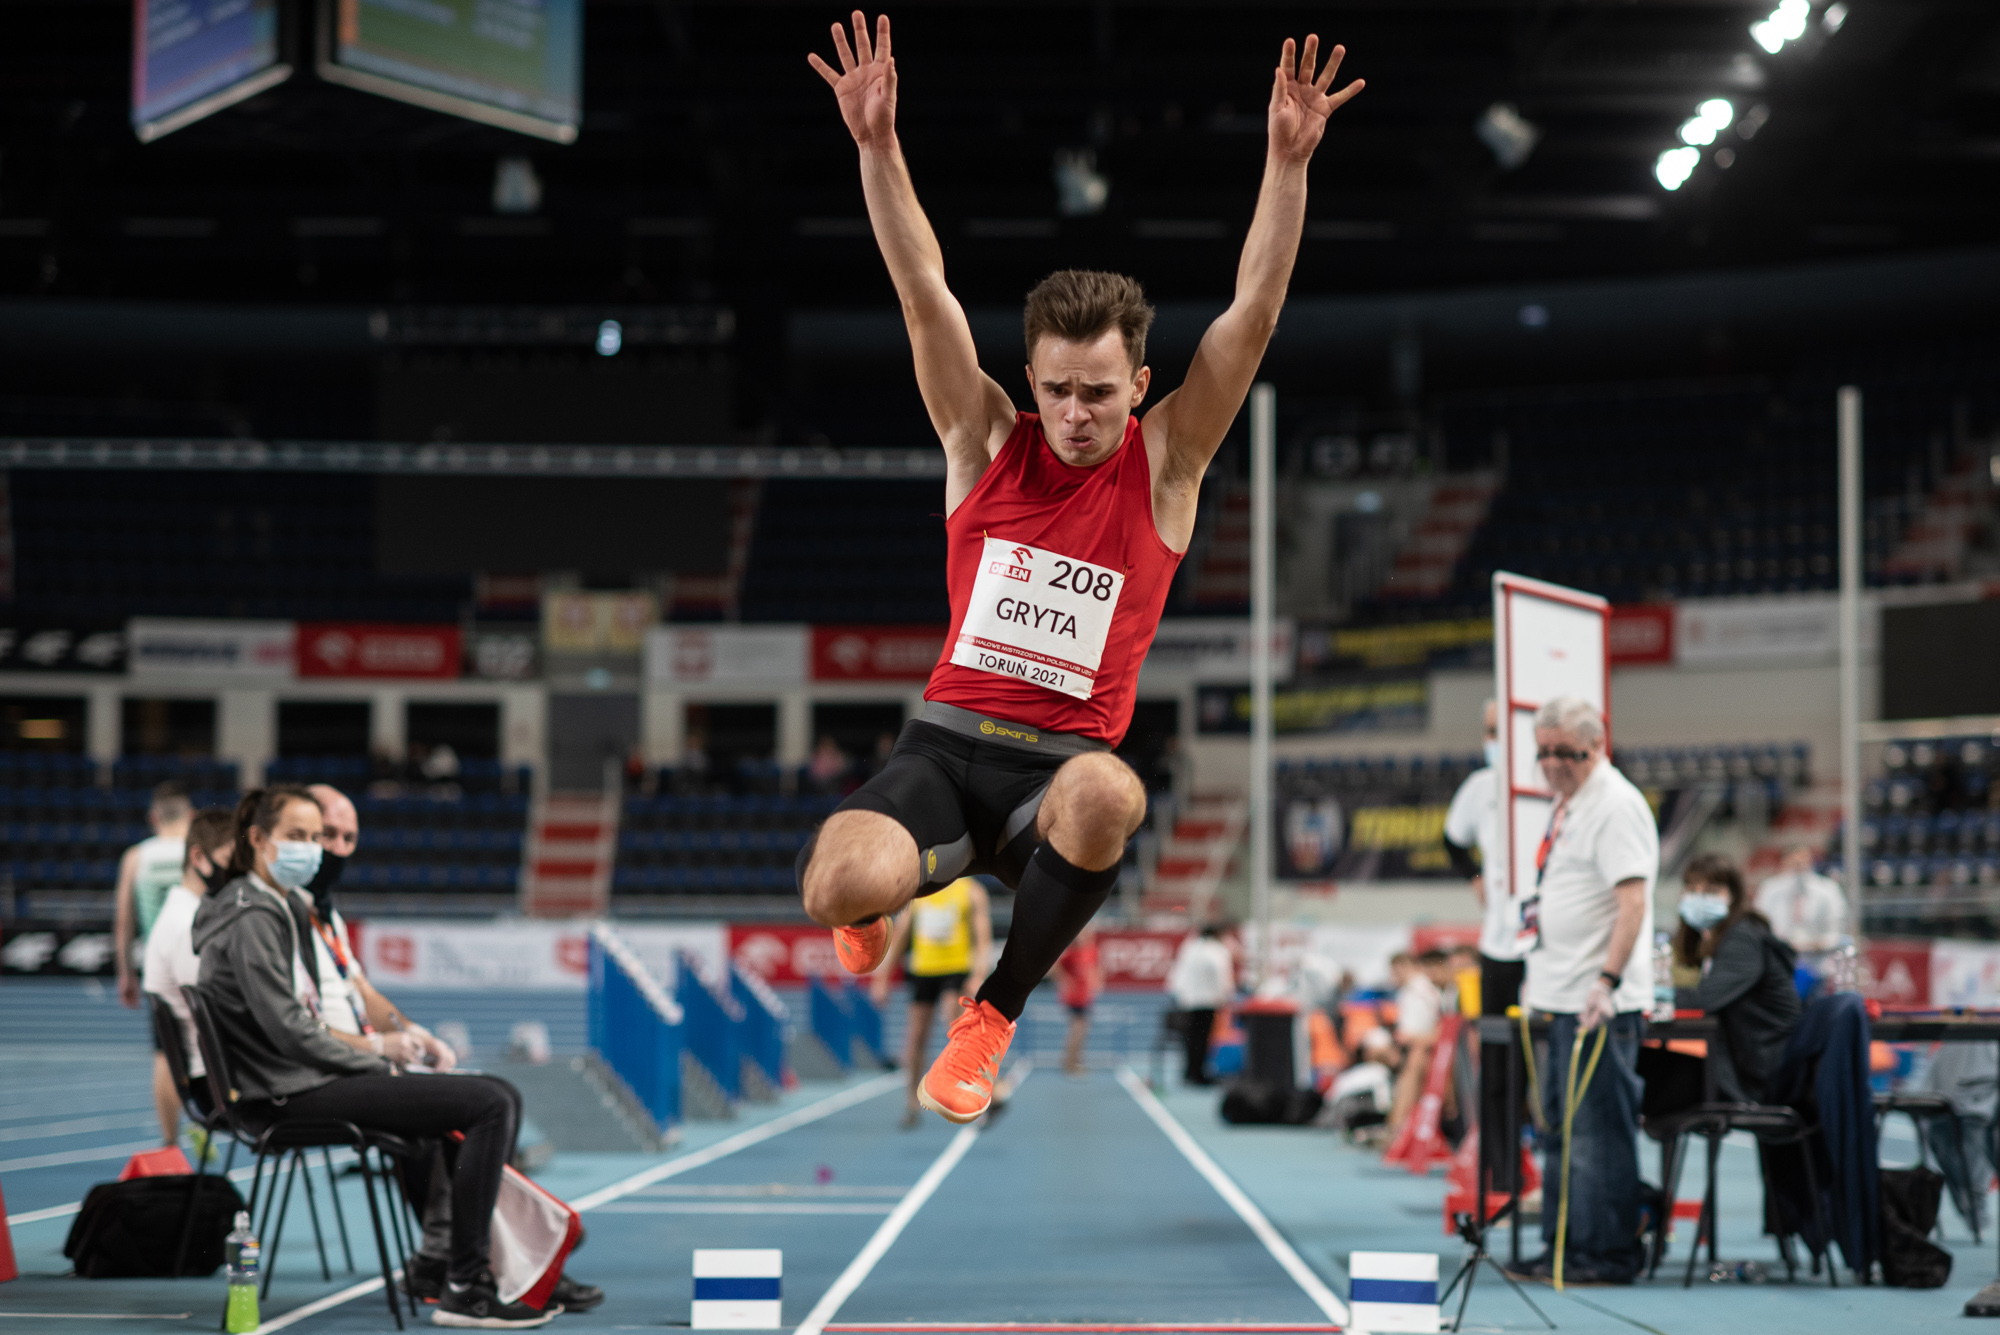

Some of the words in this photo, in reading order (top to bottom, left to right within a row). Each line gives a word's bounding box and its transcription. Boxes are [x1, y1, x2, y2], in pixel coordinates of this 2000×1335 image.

[991, 562, 1030, 582] ORLEN
[1048, 560, 1114, 601] 208
[996, 597, 1077, 639] GRYTA
[975, 639, 1001, 650] HALOWE
[1001, 645, 1046, 662] MISTRZOSTWA
[1046, 657, 1069, 668] POLSKI
[978, 652, 1028, 677] TORUŃ
[1030, 667, 1065, 687] 2021
